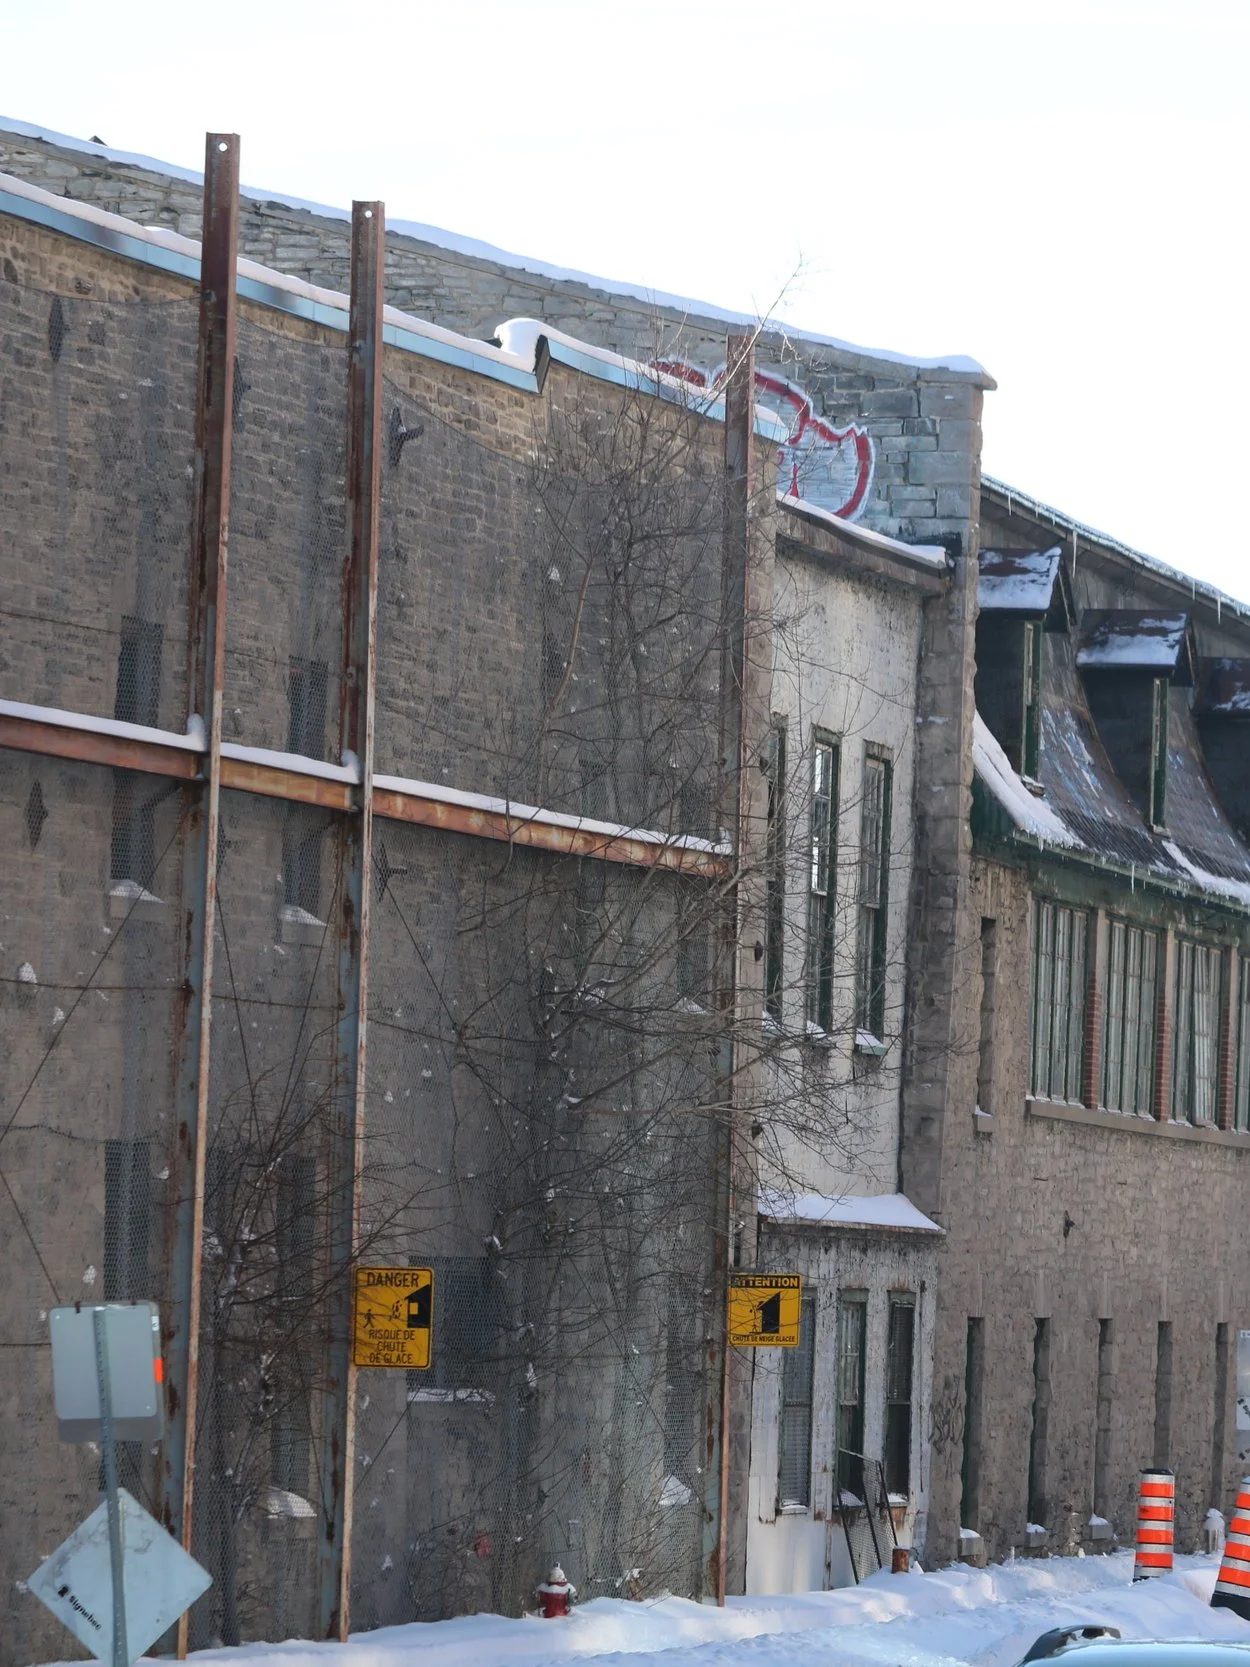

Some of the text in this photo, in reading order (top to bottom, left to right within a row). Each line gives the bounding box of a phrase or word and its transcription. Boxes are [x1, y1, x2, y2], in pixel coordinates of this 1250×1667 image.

[366, 1272, 419, 1287] DANGER
[369, 1329, 416, 1341] RISQUE DE
[377, 1341, 407, 1353] CHUTE
[369, 1352, 413, 1365] DE GLACE
[68, 1595, 103, 1631] Signebec
